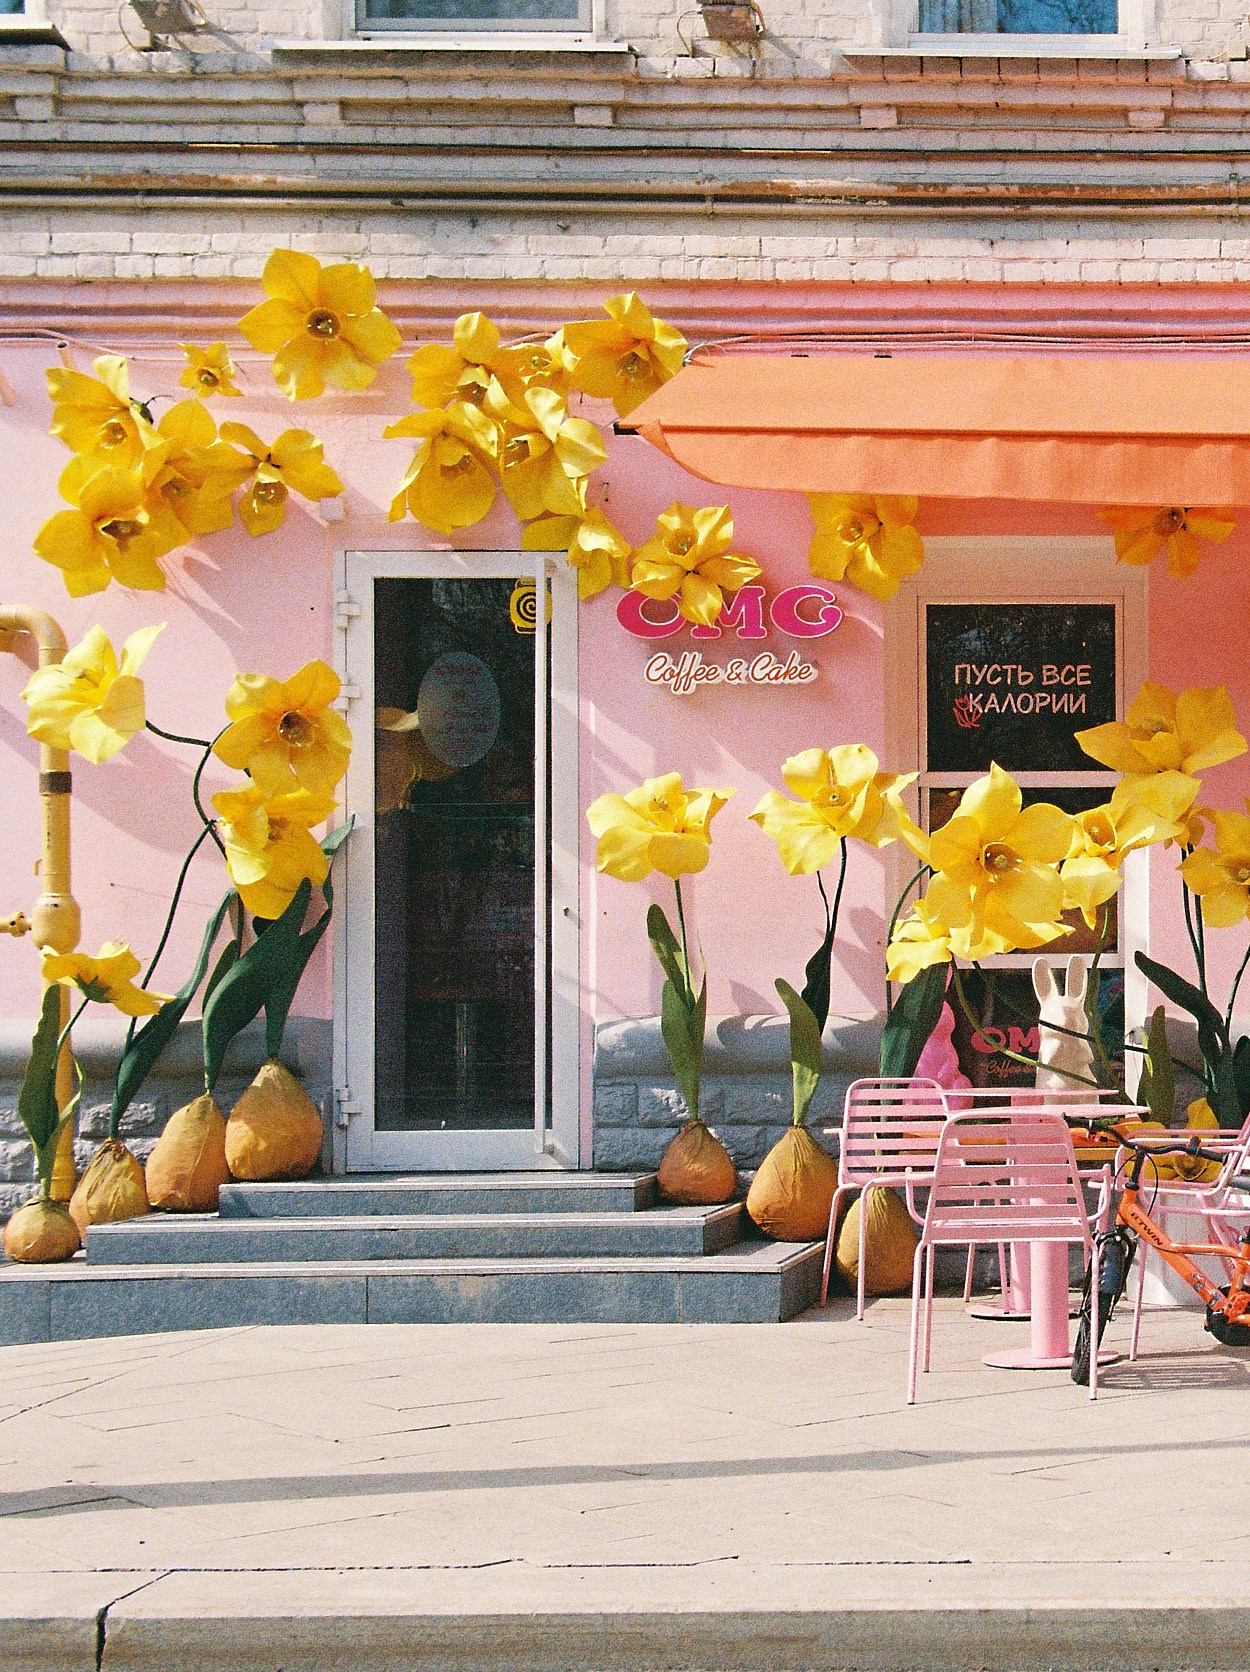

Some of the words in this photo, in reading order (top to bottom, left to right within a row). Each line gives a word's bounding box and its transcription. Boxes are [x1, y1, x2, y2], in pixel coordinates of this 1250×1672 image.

[616, 585, 843, 639] OMG
[645, 652, 720, 693] Coffee
[725, 660, 744, 684] &
[749, 651, 814, 683] Cake
[954, 663, 1034, 686] ПУСТЬ
[1041, 664, 1092, 686] ВСЕ
[968, 692, 1086, 714] КАЛОРИИ
[971, 1026, 1041, 1054] OM
